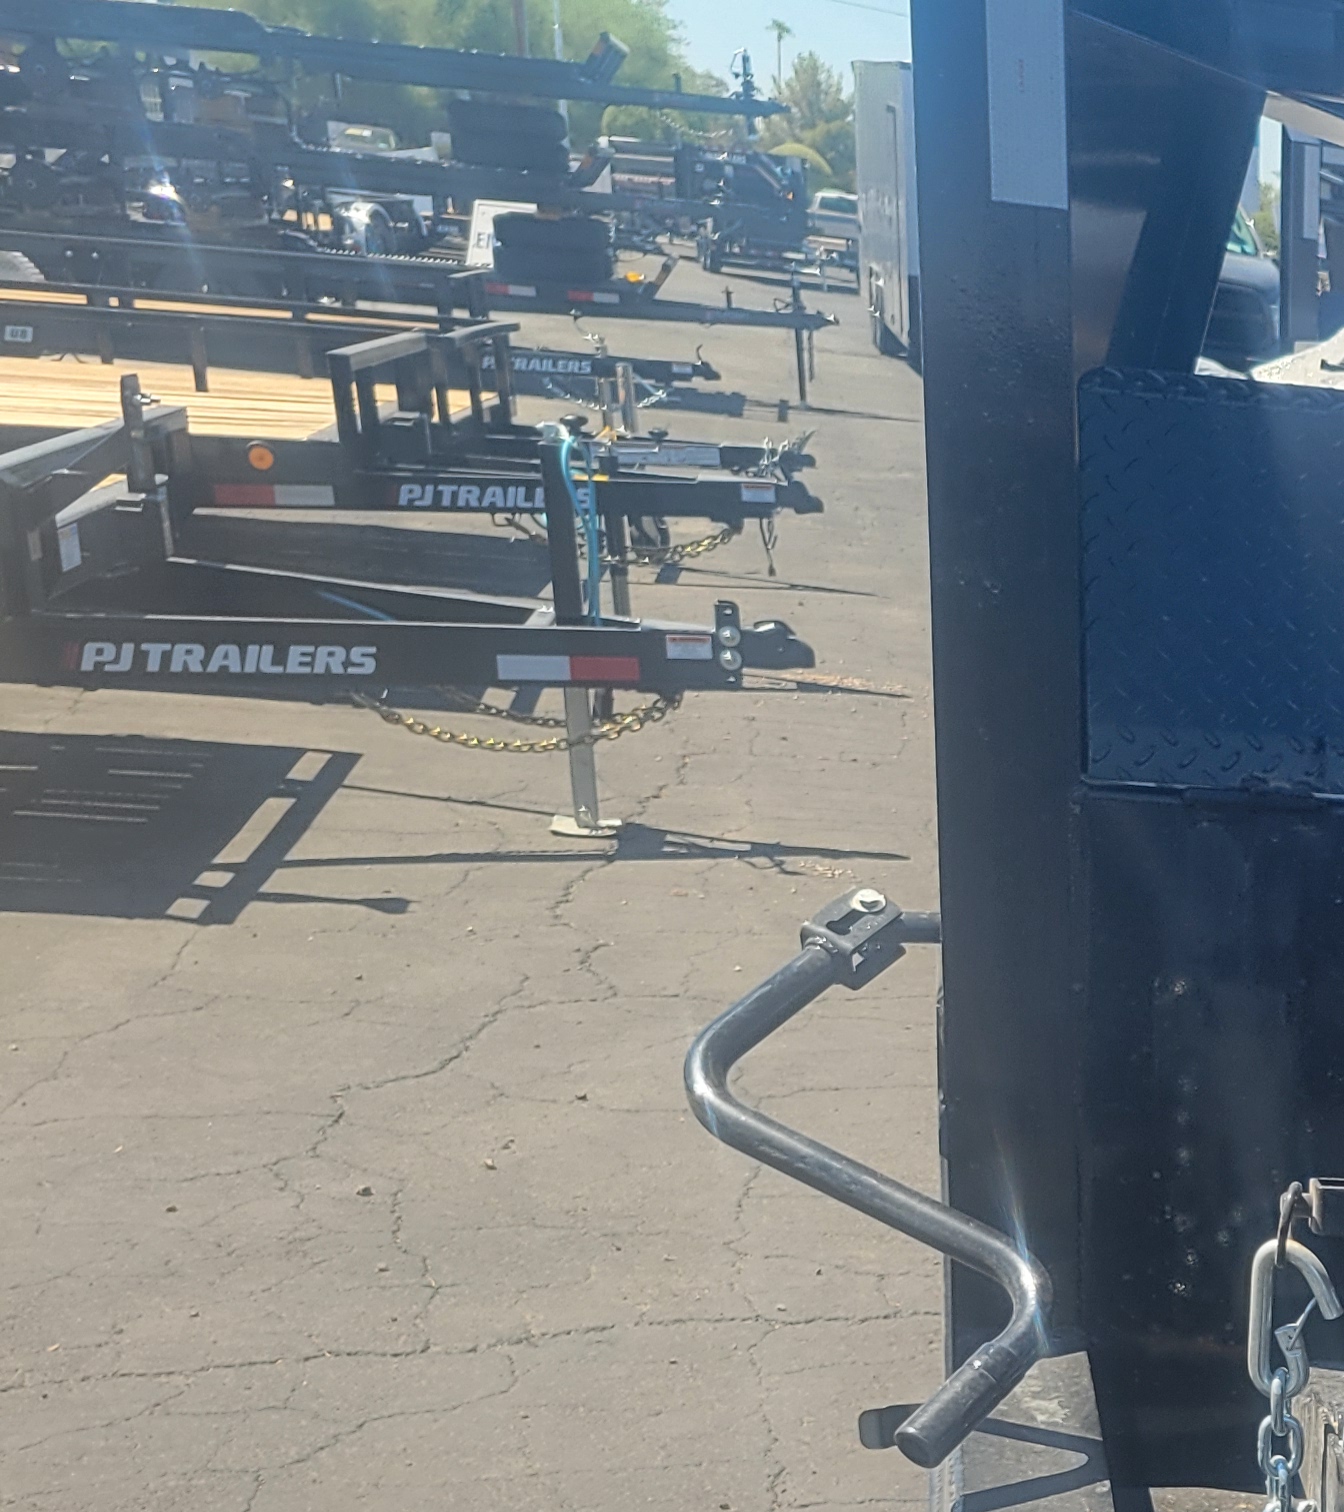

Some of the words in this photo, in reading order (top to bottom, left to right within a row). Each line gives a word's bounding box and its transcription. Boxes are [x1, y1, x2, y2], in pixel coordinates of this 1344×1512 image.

[511, 356, 593, 375] RAILERS
[398, 483, 435, 507] PJ
[436, 484, 592, 511] TRAILS
[80, 641, 135, 672] PJ
[141, 642, 378, 675] TRAILERS
